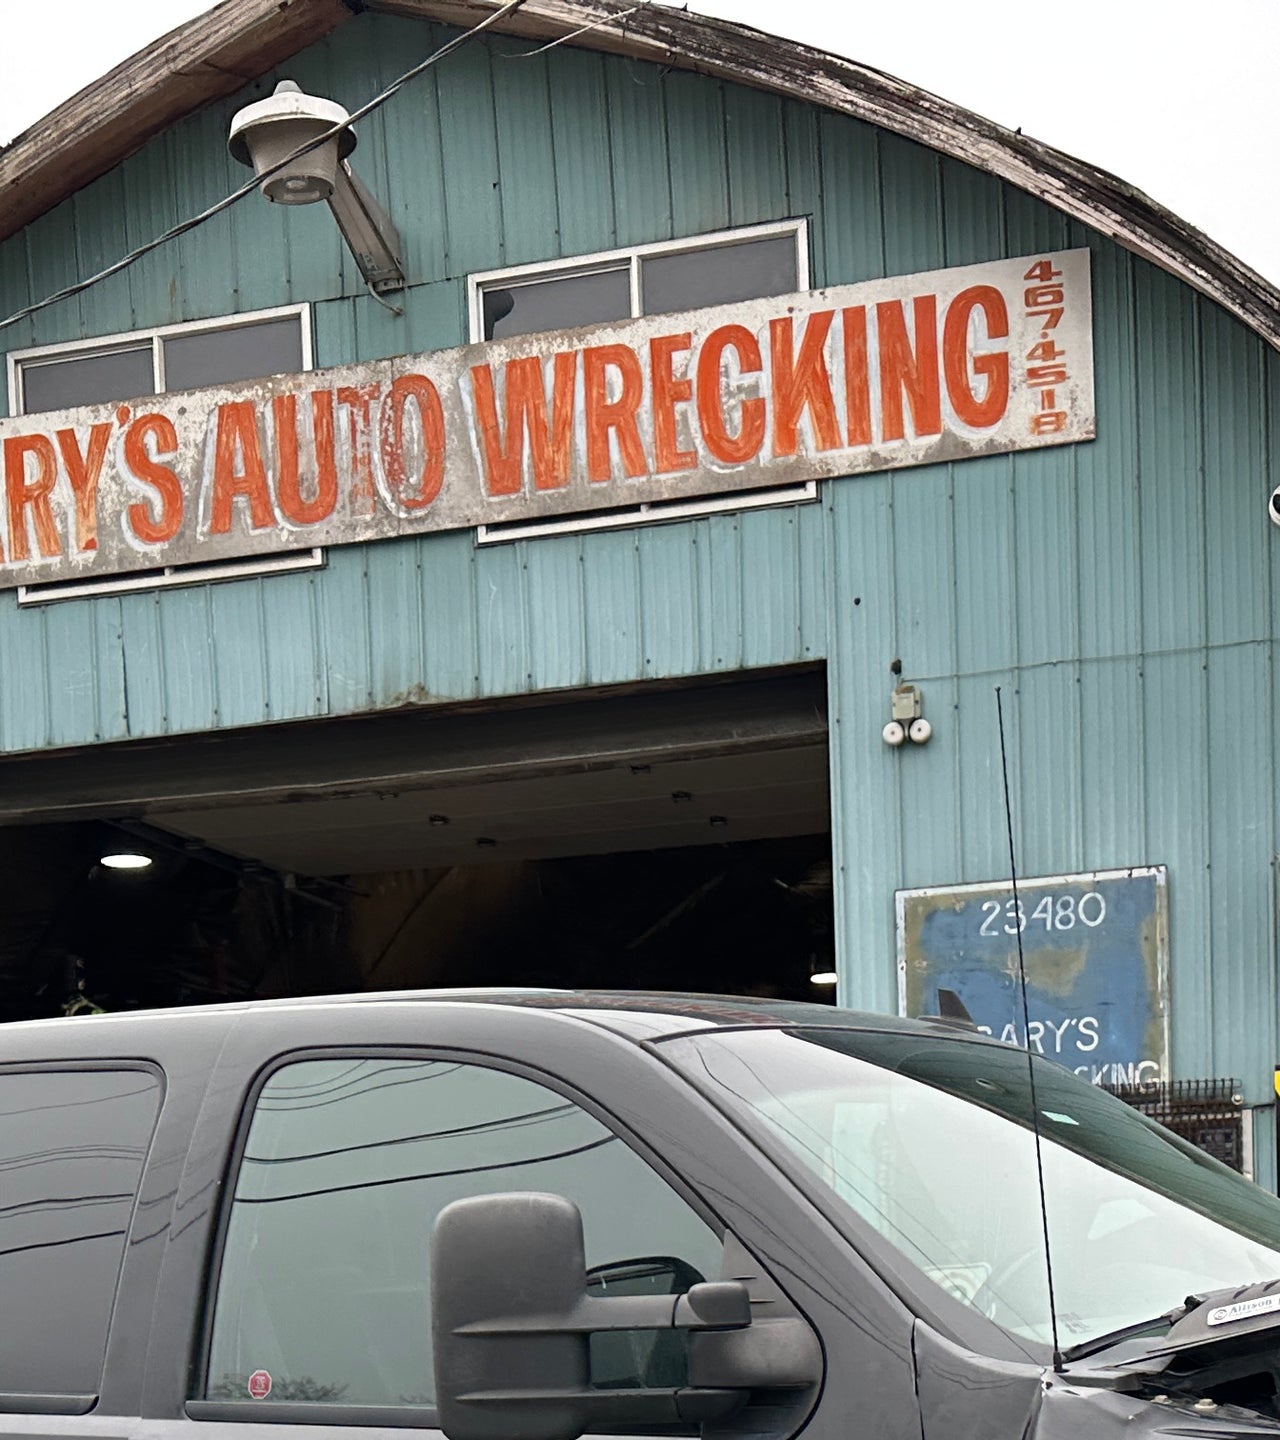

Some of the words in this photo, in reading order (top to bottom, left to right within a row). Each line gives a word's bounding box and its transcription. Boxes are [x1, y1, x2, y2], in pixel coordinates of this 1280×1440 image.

[207, 372, 446, 537] AUTO
[469, 284, 1011, 498] WRECKING
[979, 891, 1107, 937] 23480
